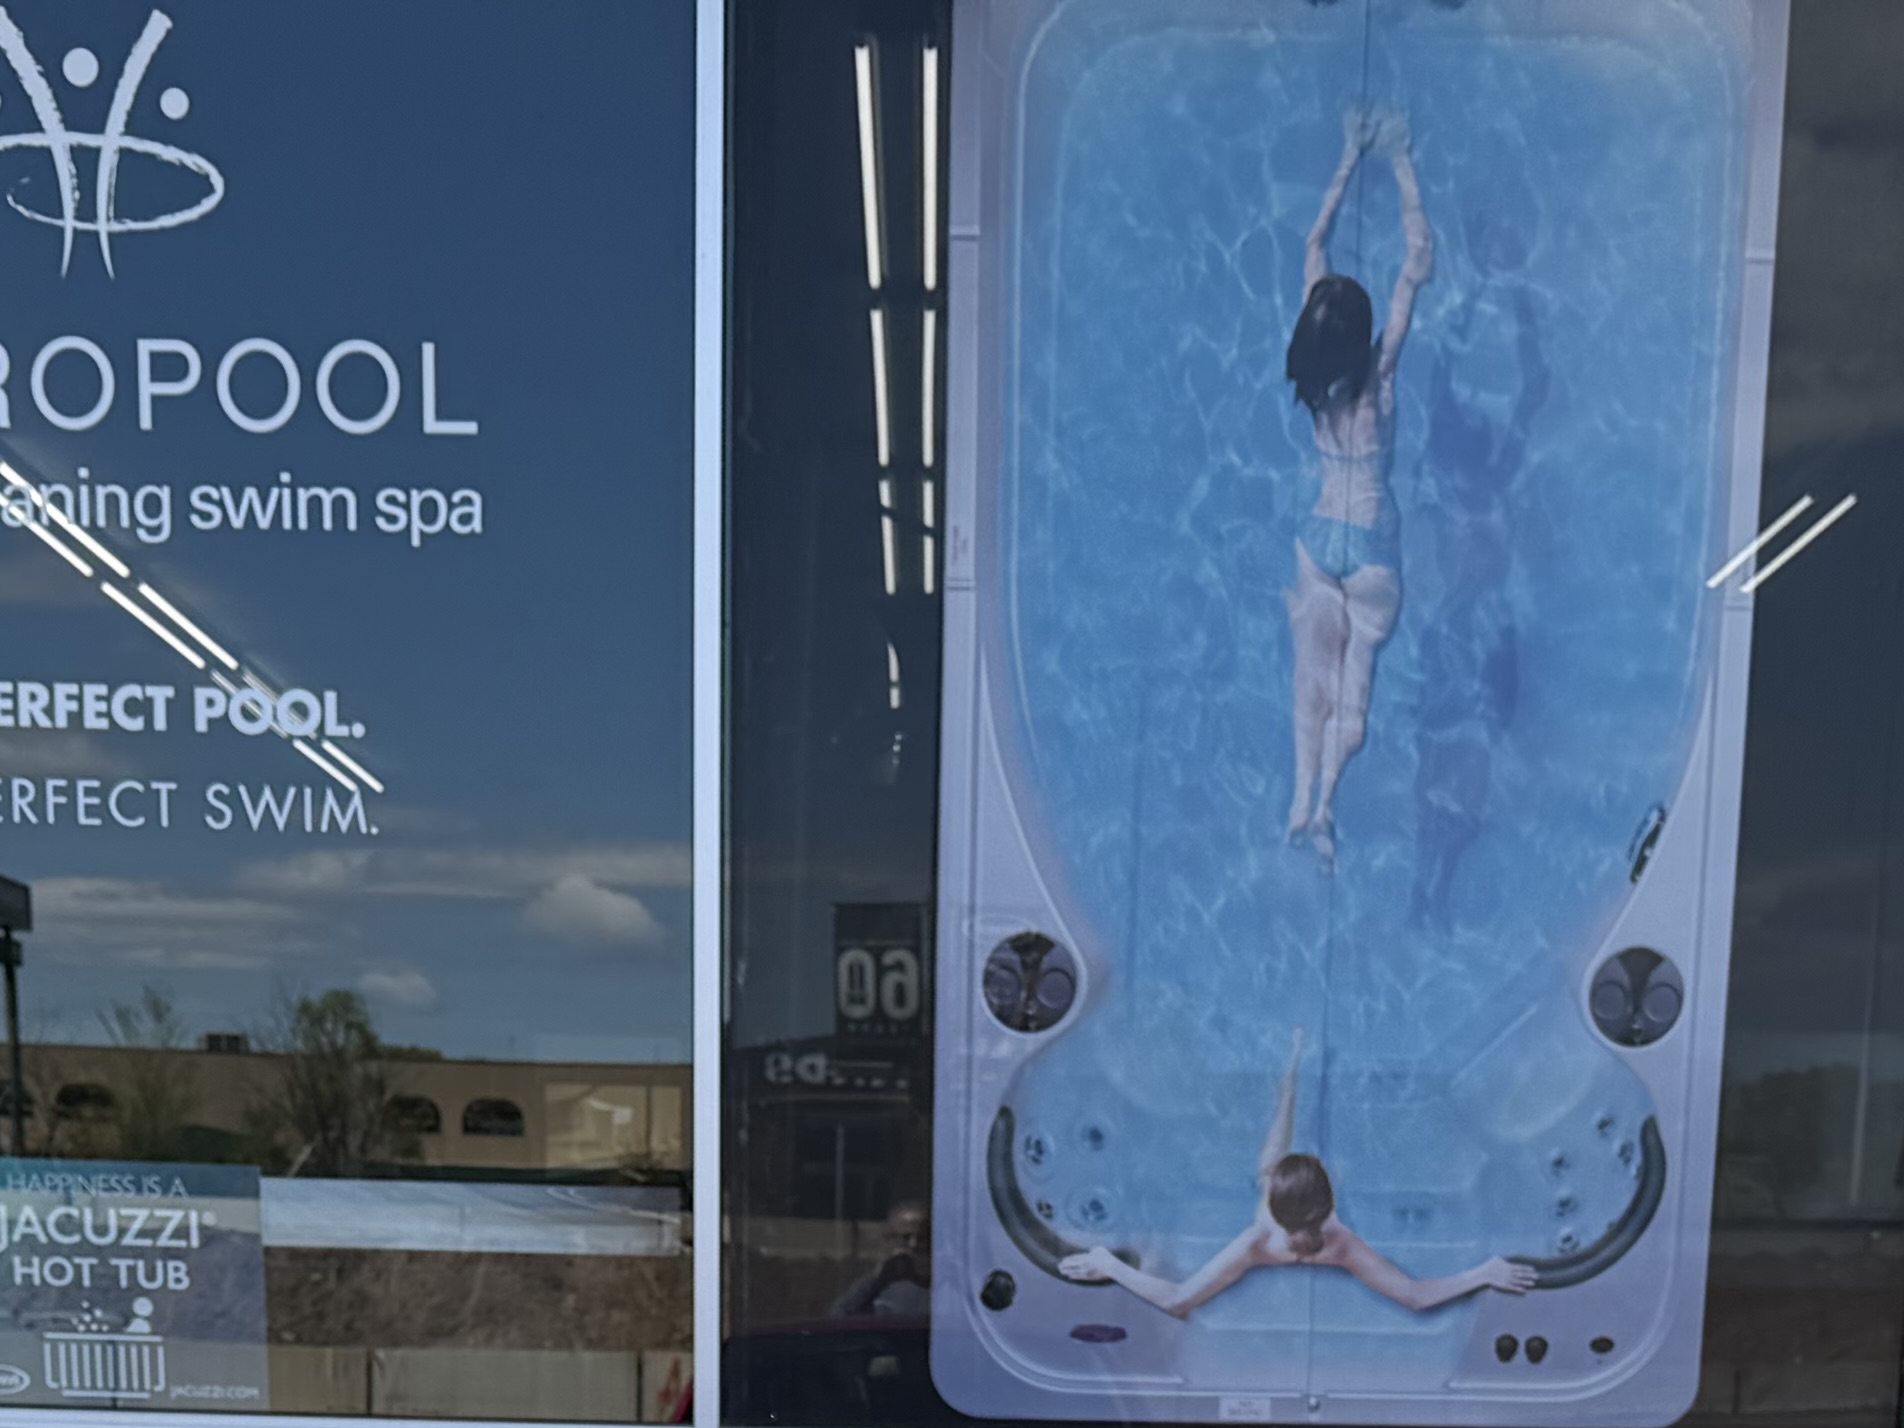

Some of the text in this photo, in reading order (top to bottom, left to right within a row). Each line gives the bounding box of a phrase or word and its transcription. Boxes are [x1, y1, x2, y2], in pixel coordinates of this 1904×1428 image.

[188, 473, 358, 532] swim
[375, 485, 484, 547] spa
[193, 686, 367, 739] POOL.
[205, 784, 380, 837] SWIM.
[6, 1173, 189, 1200] HAPPINESS IS A
[13, 1256, 192, 1291] HOT TUB
